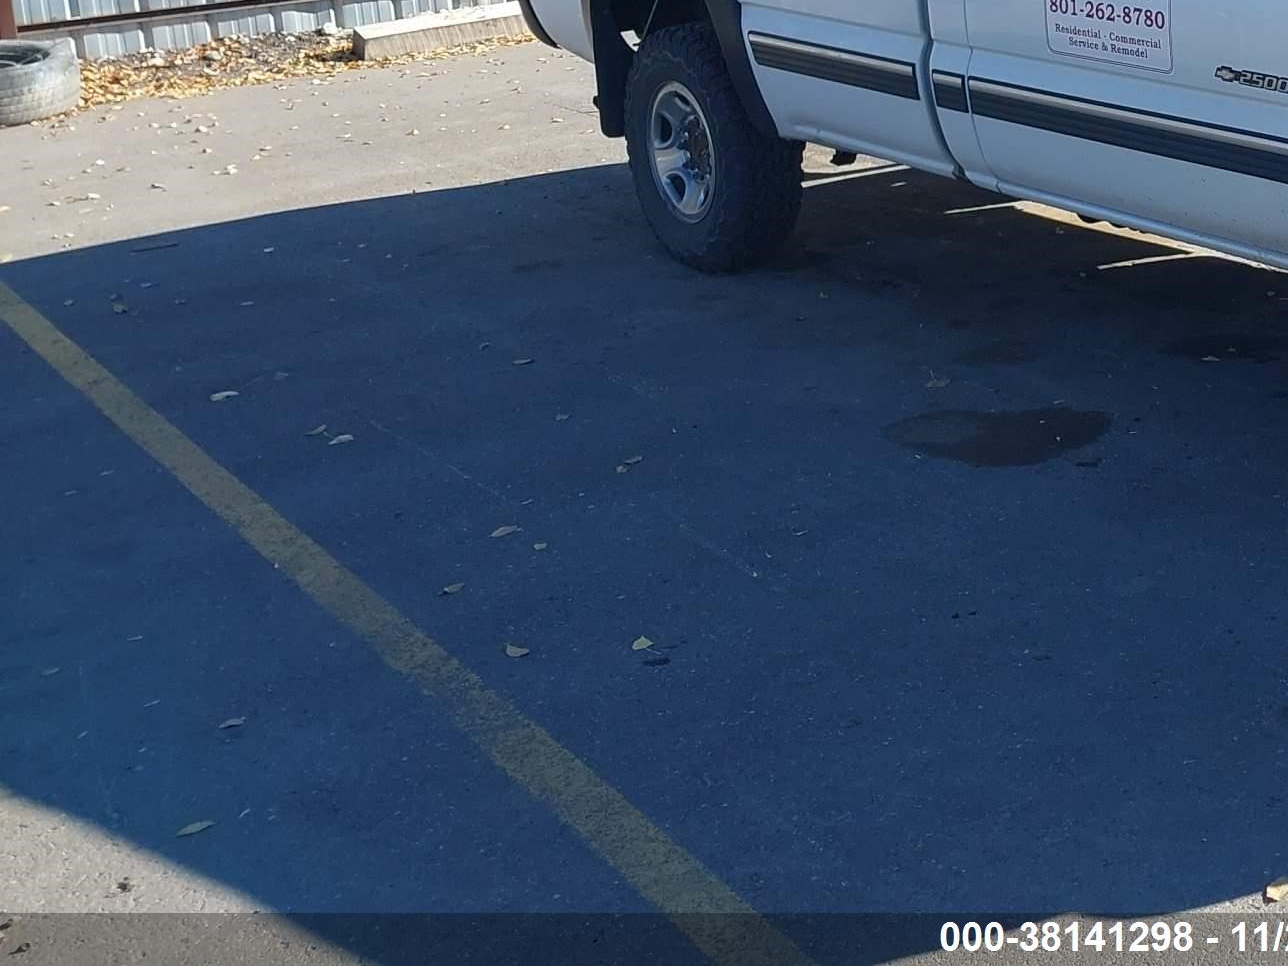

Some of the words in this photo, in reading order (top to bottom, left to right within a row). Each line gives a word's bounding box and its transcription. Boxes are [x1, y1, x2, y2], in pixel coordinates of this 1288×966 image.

[1055, 23, 1102, 40] Residential
[1109, 32, 1162, 50] Commercial
[1068, 36, 1099, 51] Service
[1101, 42, 1109, 52] &
[1111, 43, 1149, 59] Remodel
